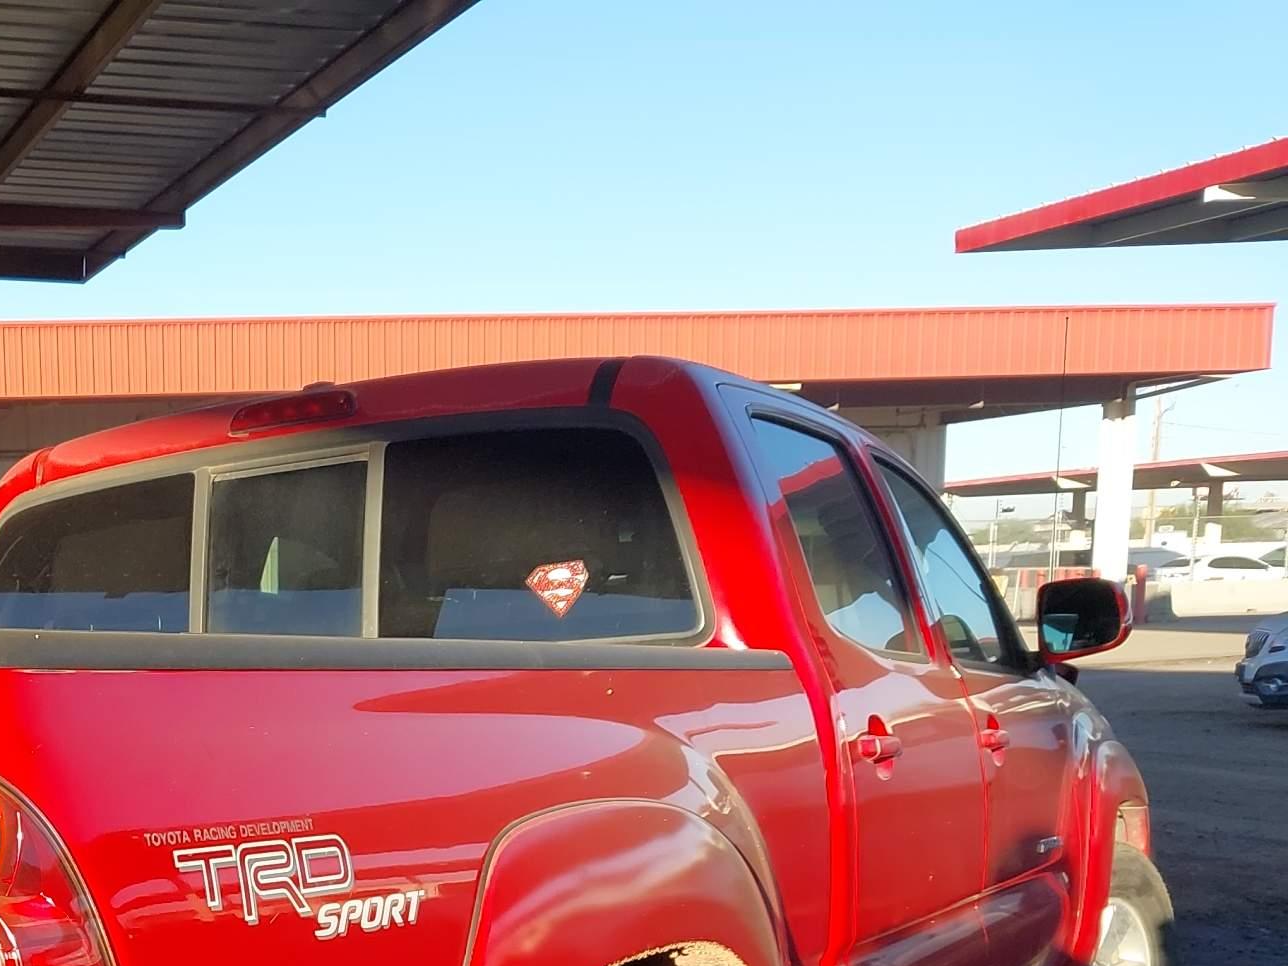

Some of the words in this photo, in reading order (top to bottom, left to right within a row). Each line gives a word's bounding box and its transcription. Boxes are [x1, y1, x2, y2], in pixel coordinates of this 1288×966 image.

[144, 830, 191, 846] TOYOTA
[194, 826, 237, 842] RACING
[240, 819, 314, 838] DEVELOPMENT
[173, 834, 355, 925] TRD
[314, 889, 426, 941] SPORT
